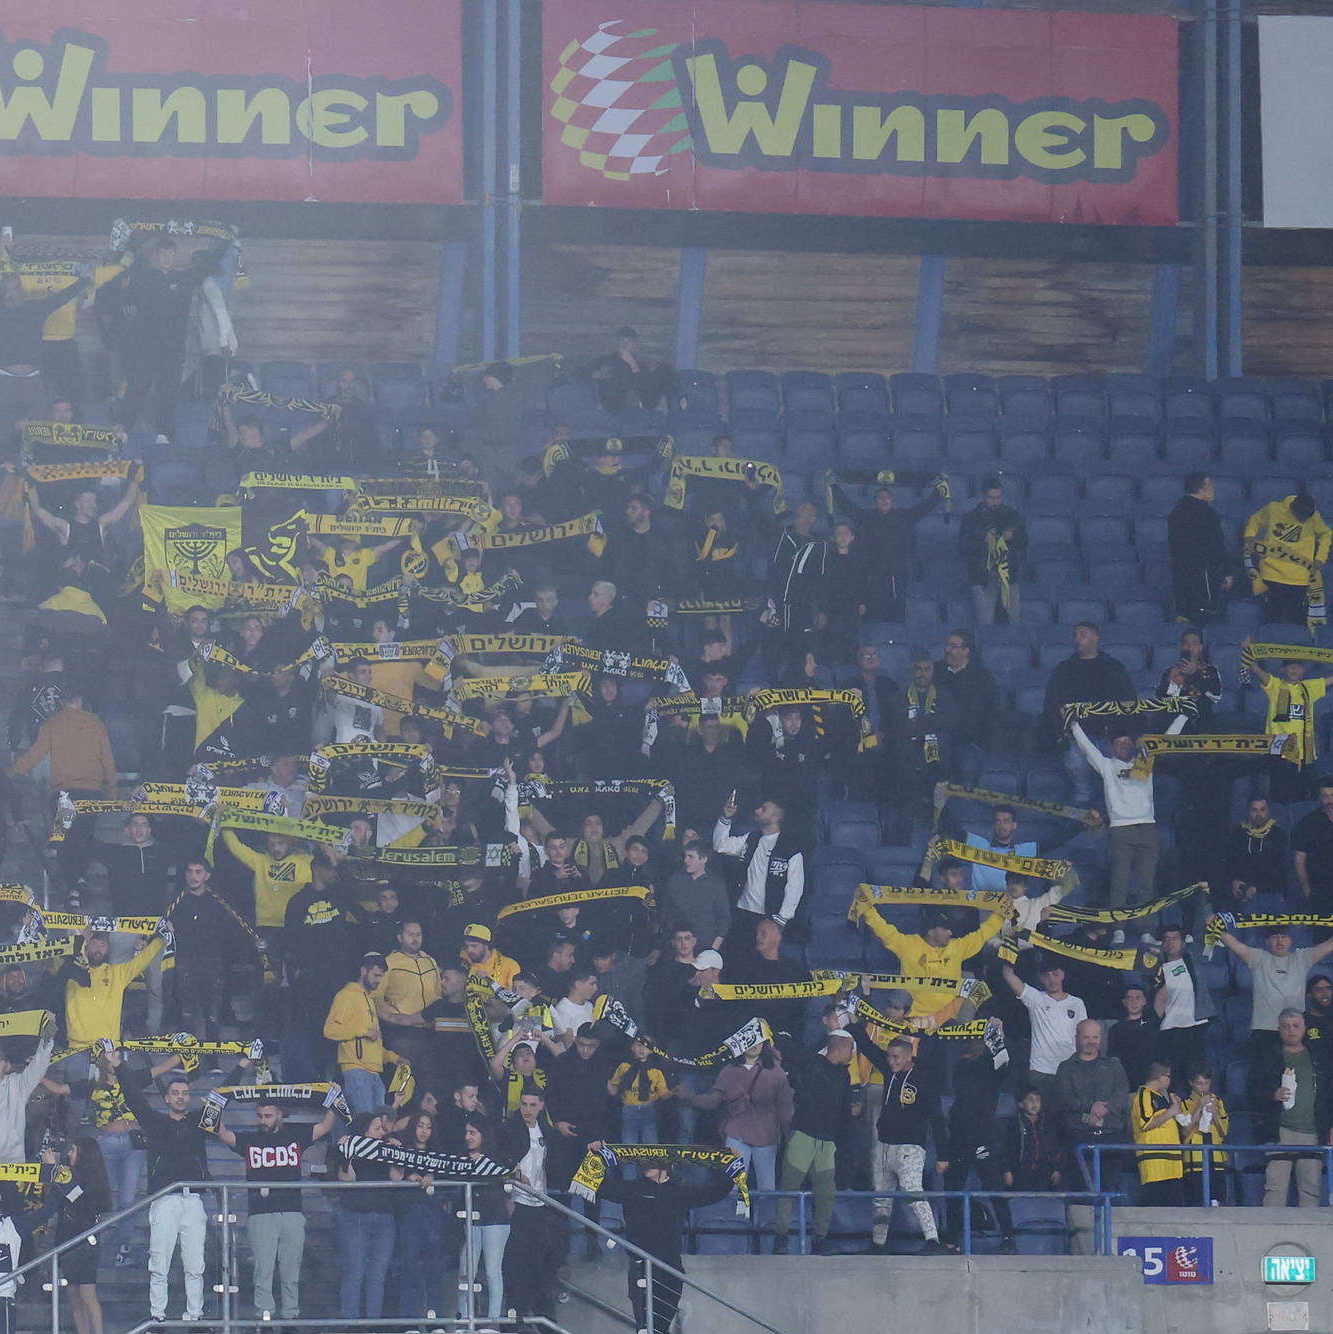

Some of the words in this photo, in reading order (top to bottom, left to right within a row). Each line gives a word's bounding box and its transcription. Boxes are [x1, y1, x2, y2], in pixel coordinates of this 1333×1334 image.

[687, 54, 1156, 168] Winner
[492, 525, 575, 547] ירושלים
[471, 636, 556, 652] ירושלים
[379, 848, 456, 863] Jerusalem
[249, 1144, 298, 1168] GCDS
[0, 1163, 39, 1176] בית"ר
[1270, 1258, 1311, 1282] יציאה
